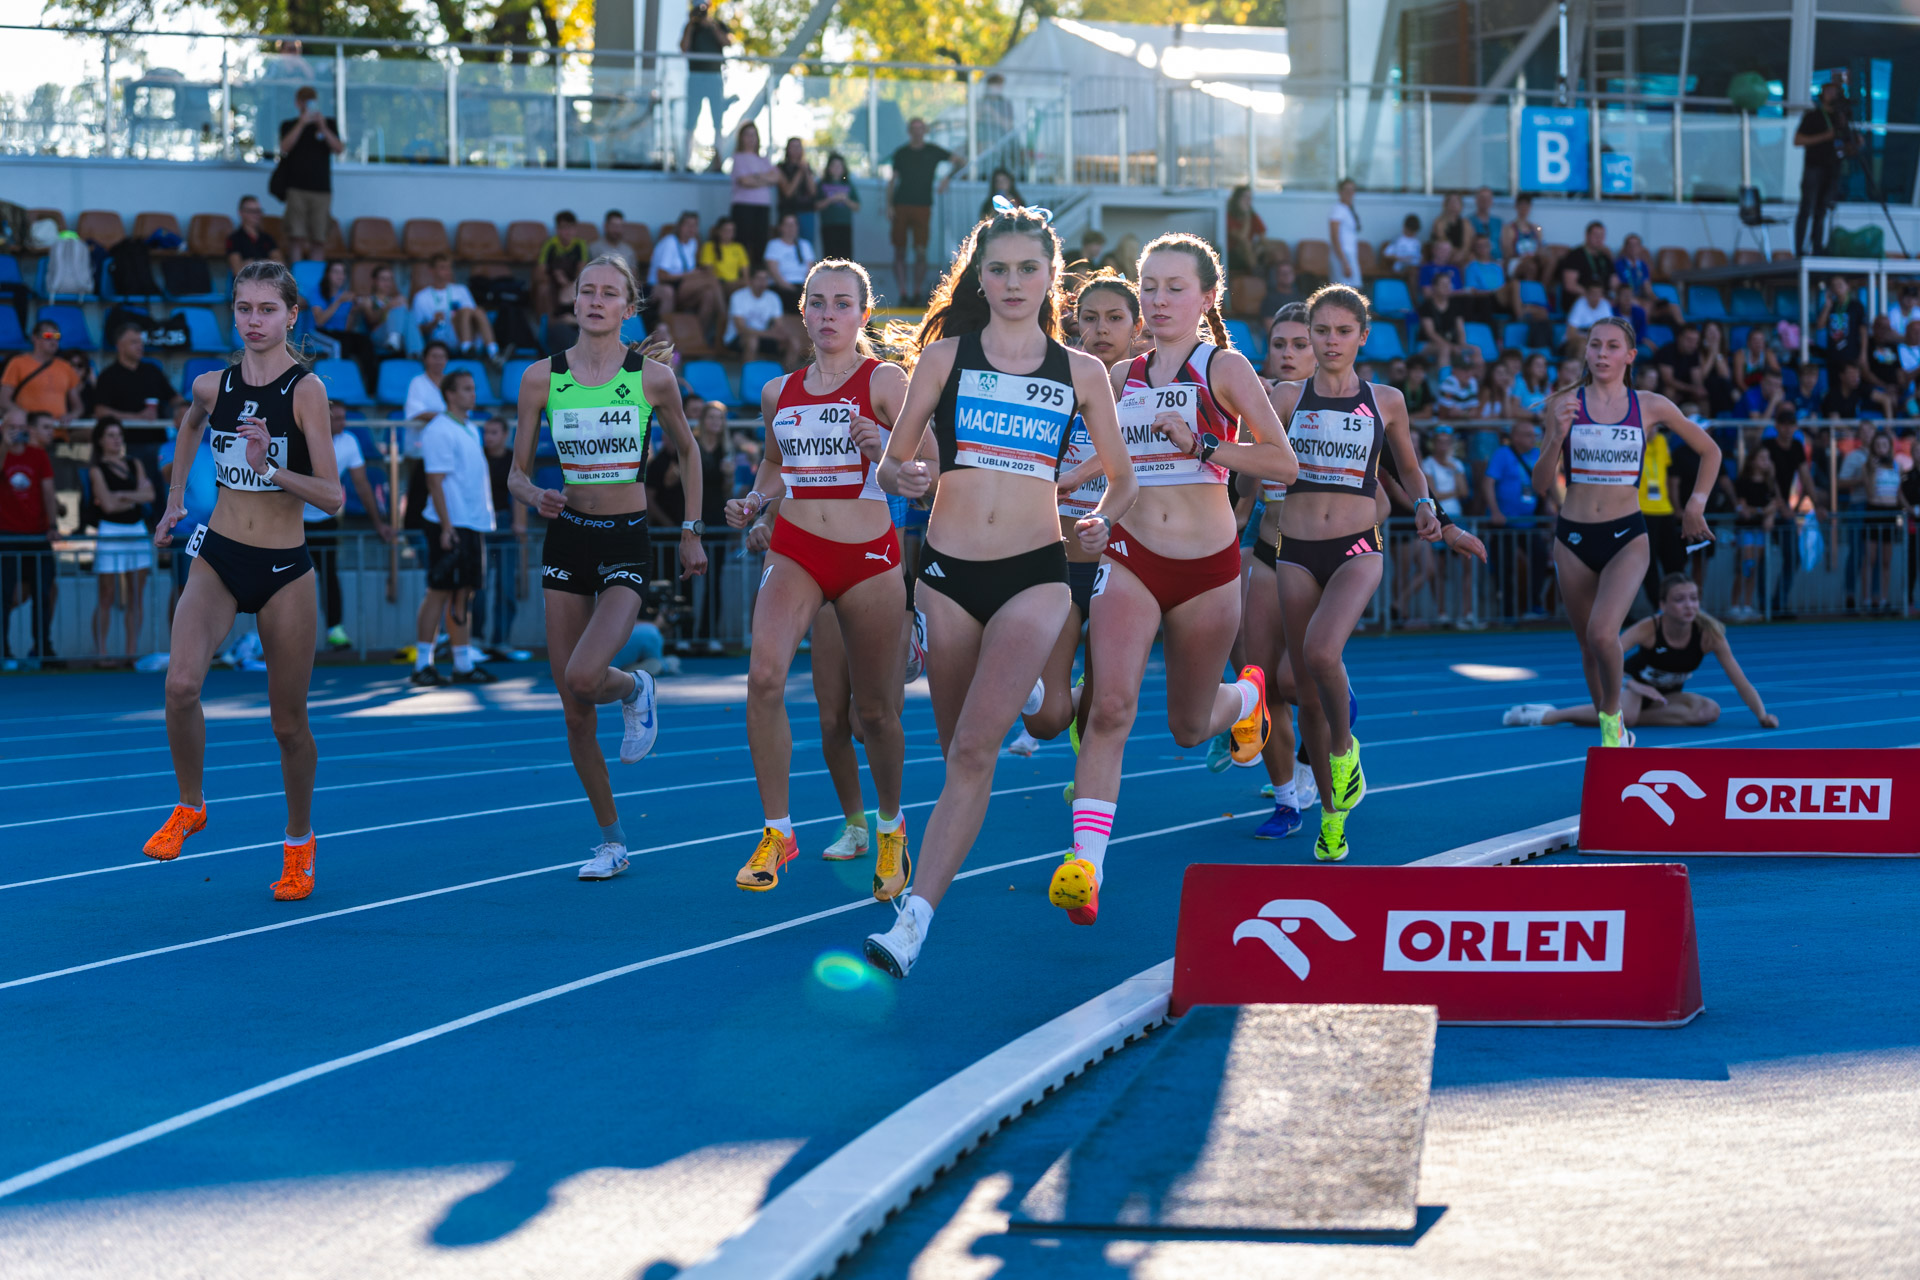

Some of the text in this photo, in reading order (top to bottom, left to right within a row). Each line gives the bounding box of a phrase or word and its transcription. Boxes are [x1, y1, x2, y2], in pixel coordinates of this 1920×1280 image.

[1537, 130, 1571, 184] B
[1026, 383, 1064, 406] 995
[1156, 390, 1188, 409] 780
[599, 410, 631, 426] 444
[819, 407, 850, 424] 402
[958, 407, 1061, 446] MACIEJEWSKA
[1342, 417, 1362, 432] 15
[1612, 428, 1636, 441] 751
[212, 434, 237, 454] 4F
[557, 437, 638, 458] BĘTKOWSKA
[779, 437, 857, 456] NIEMYJSKA
[977, 456, 1035, 472] LUBLIN 2025
[1573, 448, 1638, 463] NOWAKOWSKA
[577, 472, 600, 480] LUBLIN
[1134, 463, 1175, 472] LUBLIN 2025
[1305, 472, 1344, 482] LUBLIN 2025
[560, 510, 615, 528] NIKE PRO
[603, 570, 643, 584] PRO
[1735, 784, 1880, 813] ORLEN
[1398, 919, 1608, 962] ORLEN
